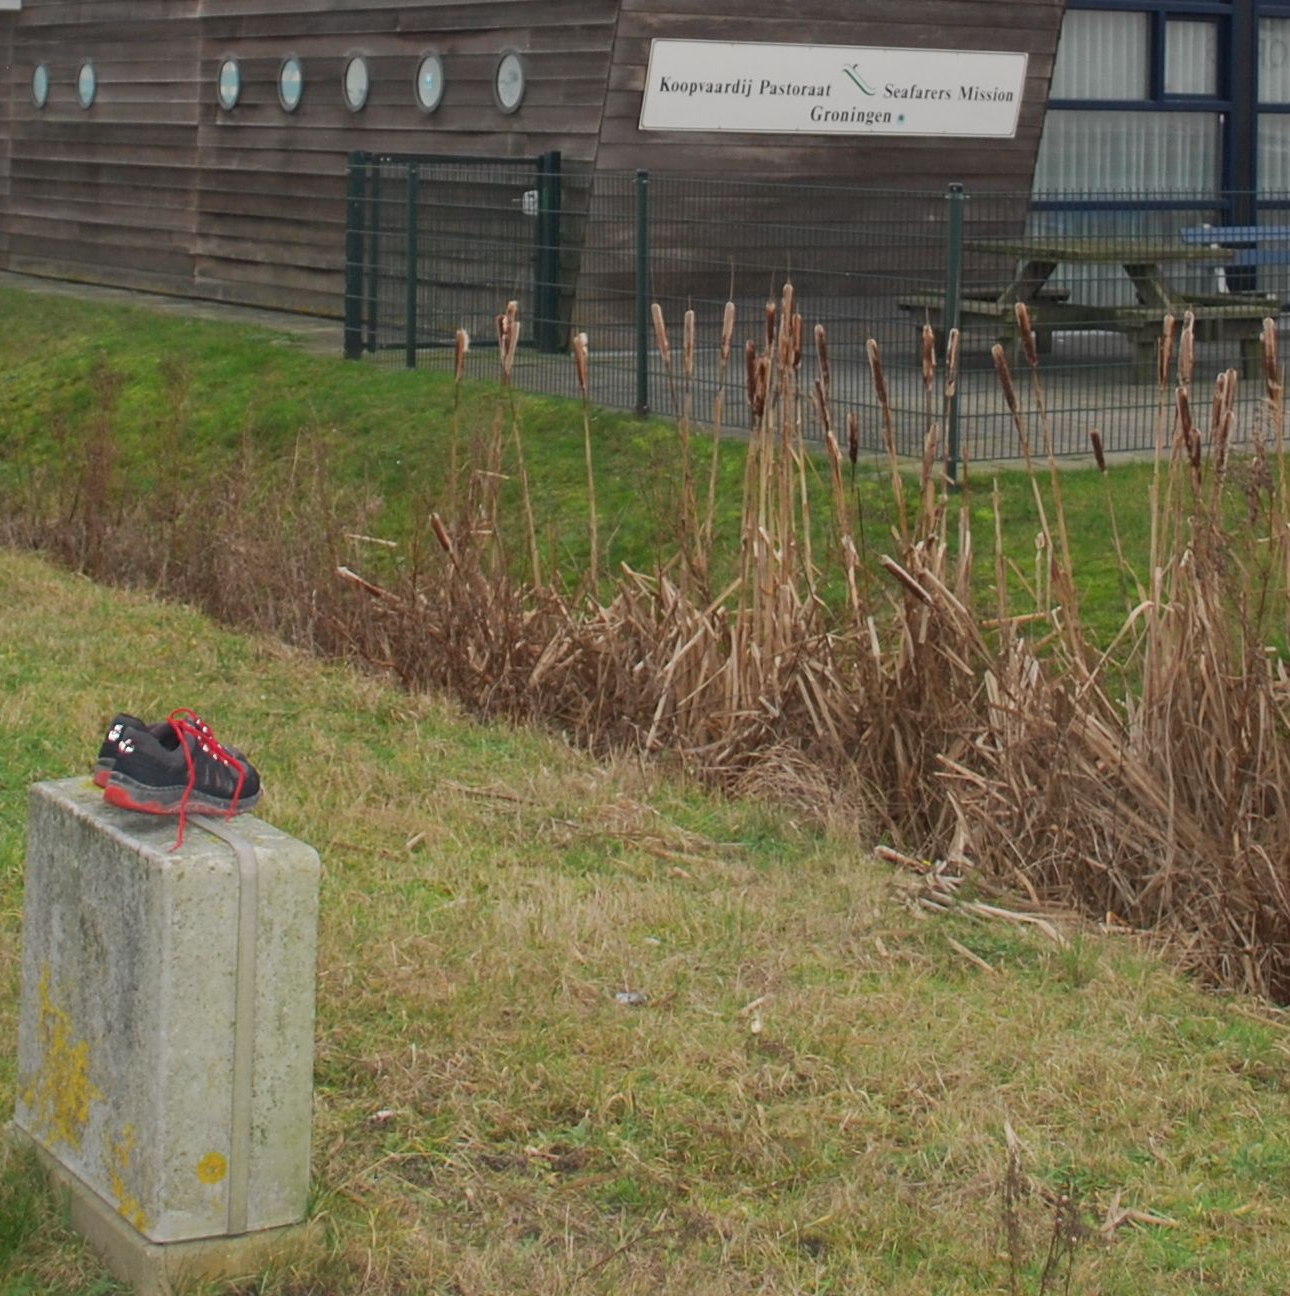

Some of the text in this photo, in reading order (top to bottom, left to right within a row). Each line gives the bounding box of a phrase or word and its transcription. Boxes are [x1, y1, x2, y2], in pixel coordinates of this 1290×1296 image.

[659, 76, 1015, 103] Koopvaardij Pastoraat Seafarers Mission
[810, 105, 893, 126] Groningen
